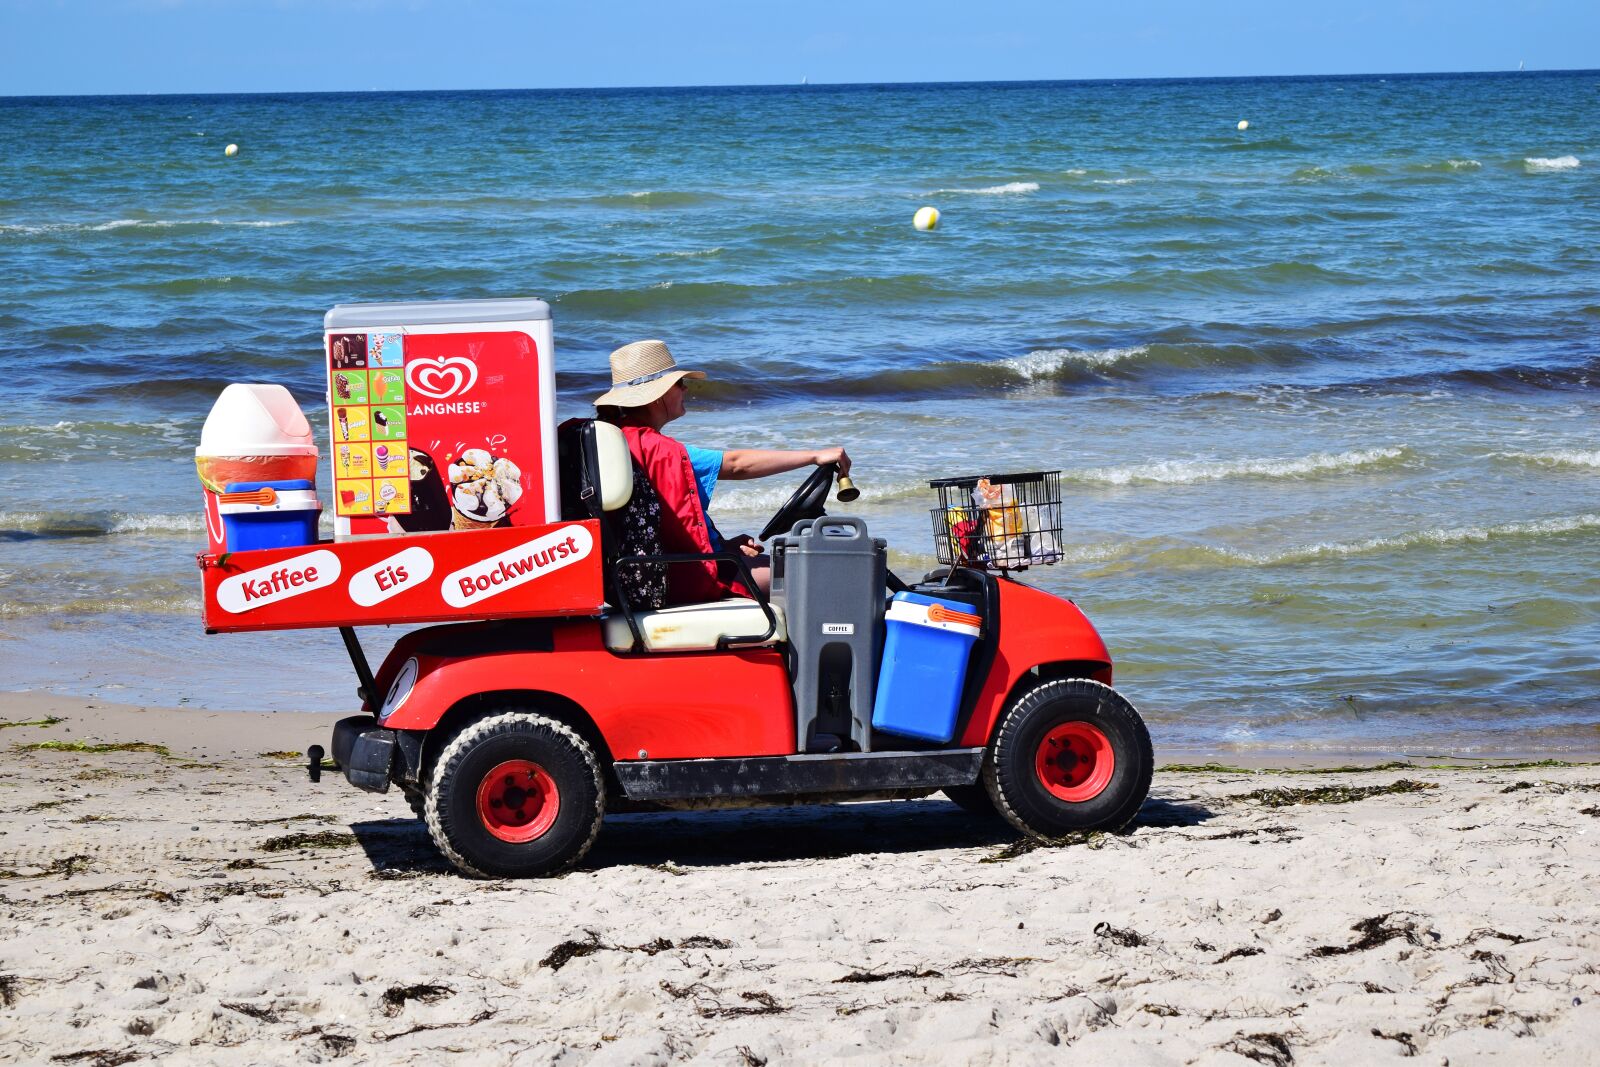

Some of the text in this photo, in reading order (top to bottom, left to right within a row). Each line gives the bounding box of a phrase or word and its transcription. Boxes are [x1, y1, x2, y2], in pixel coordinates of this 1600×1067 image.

[241, 565, 319, 602] Kaffee
[374, 565, 409, 592] Eis
[458, 536, 579, 597] Bockwurst
